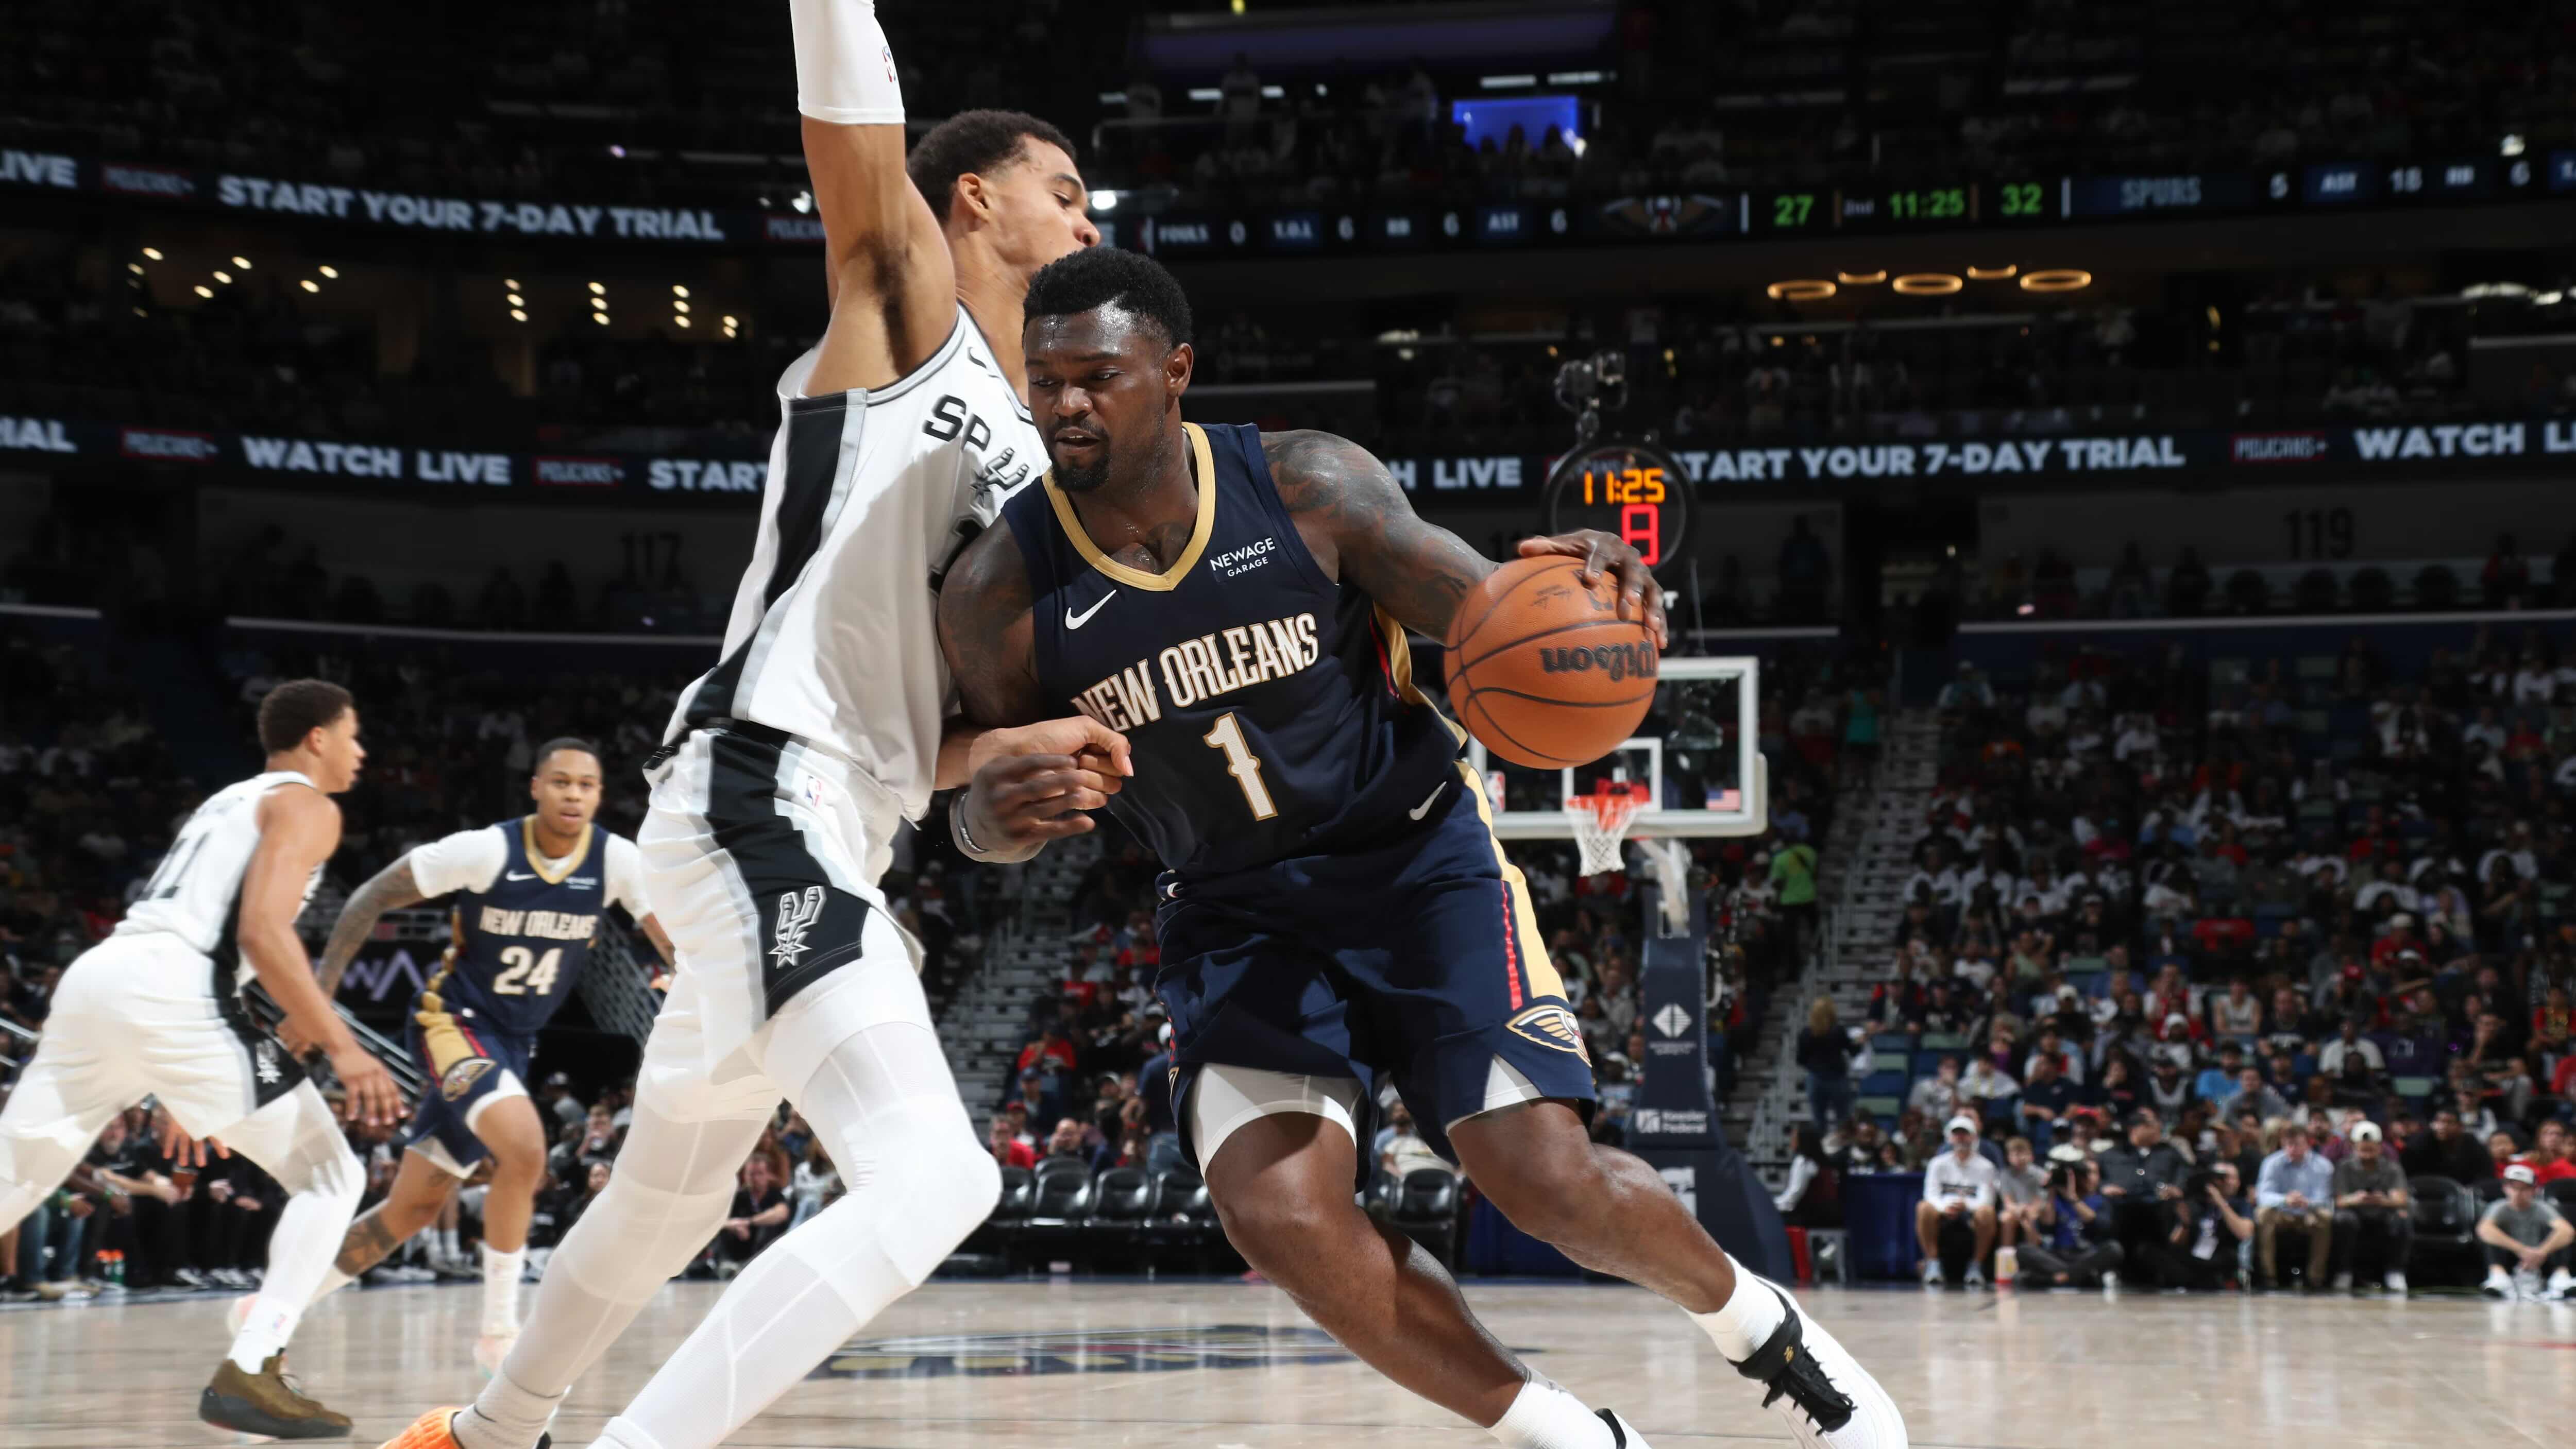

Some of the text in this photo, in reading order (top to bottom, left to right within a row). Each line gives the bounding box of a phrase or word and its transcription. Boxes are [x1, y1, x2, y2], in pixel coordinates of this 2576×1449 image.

[0, 148, 77, 187] IVE
[218, 174, 724, 240] START YOUR 7-DAY TRIAL
[1773, 193, 1815, 228] 27
[1889, 187, 1965, 219] 11:25
[2000, 182, 2042, 217] 32
[2120, 175, 2201, 208] SPURS
[1229, 219, 1246, 246] 0
[1443, 212, 1460, 237] 6
[0, 416, 77, 452] IAL
[2352, 420, 2526, 461] WATCH
[241, 435, 512, 487] WATCH LIVE
[1432, 456, 1523, 490] LIVE
[1799, 444, 1916, 479] YOUR
[1922, 440, 2053, 475] 7-DAY
[2059, 435, 2186, 471] TRIAL
[1583, 466, 1666, 506] 11:25
[1210, 537, 1276, 571] NEWAGE
[1621, 503, 1659, 566] 8
[2285, 507, 2355, 560] 119
[1227, 556, 1268, 577] GARAGE
[1070, 612, 1319, 732] NEW ORLEANS
[1202, 711, 1278, 822] 1
[479, 905, 599, 941] NEW ORLEANS
[493, 945, 564, 996] 24
